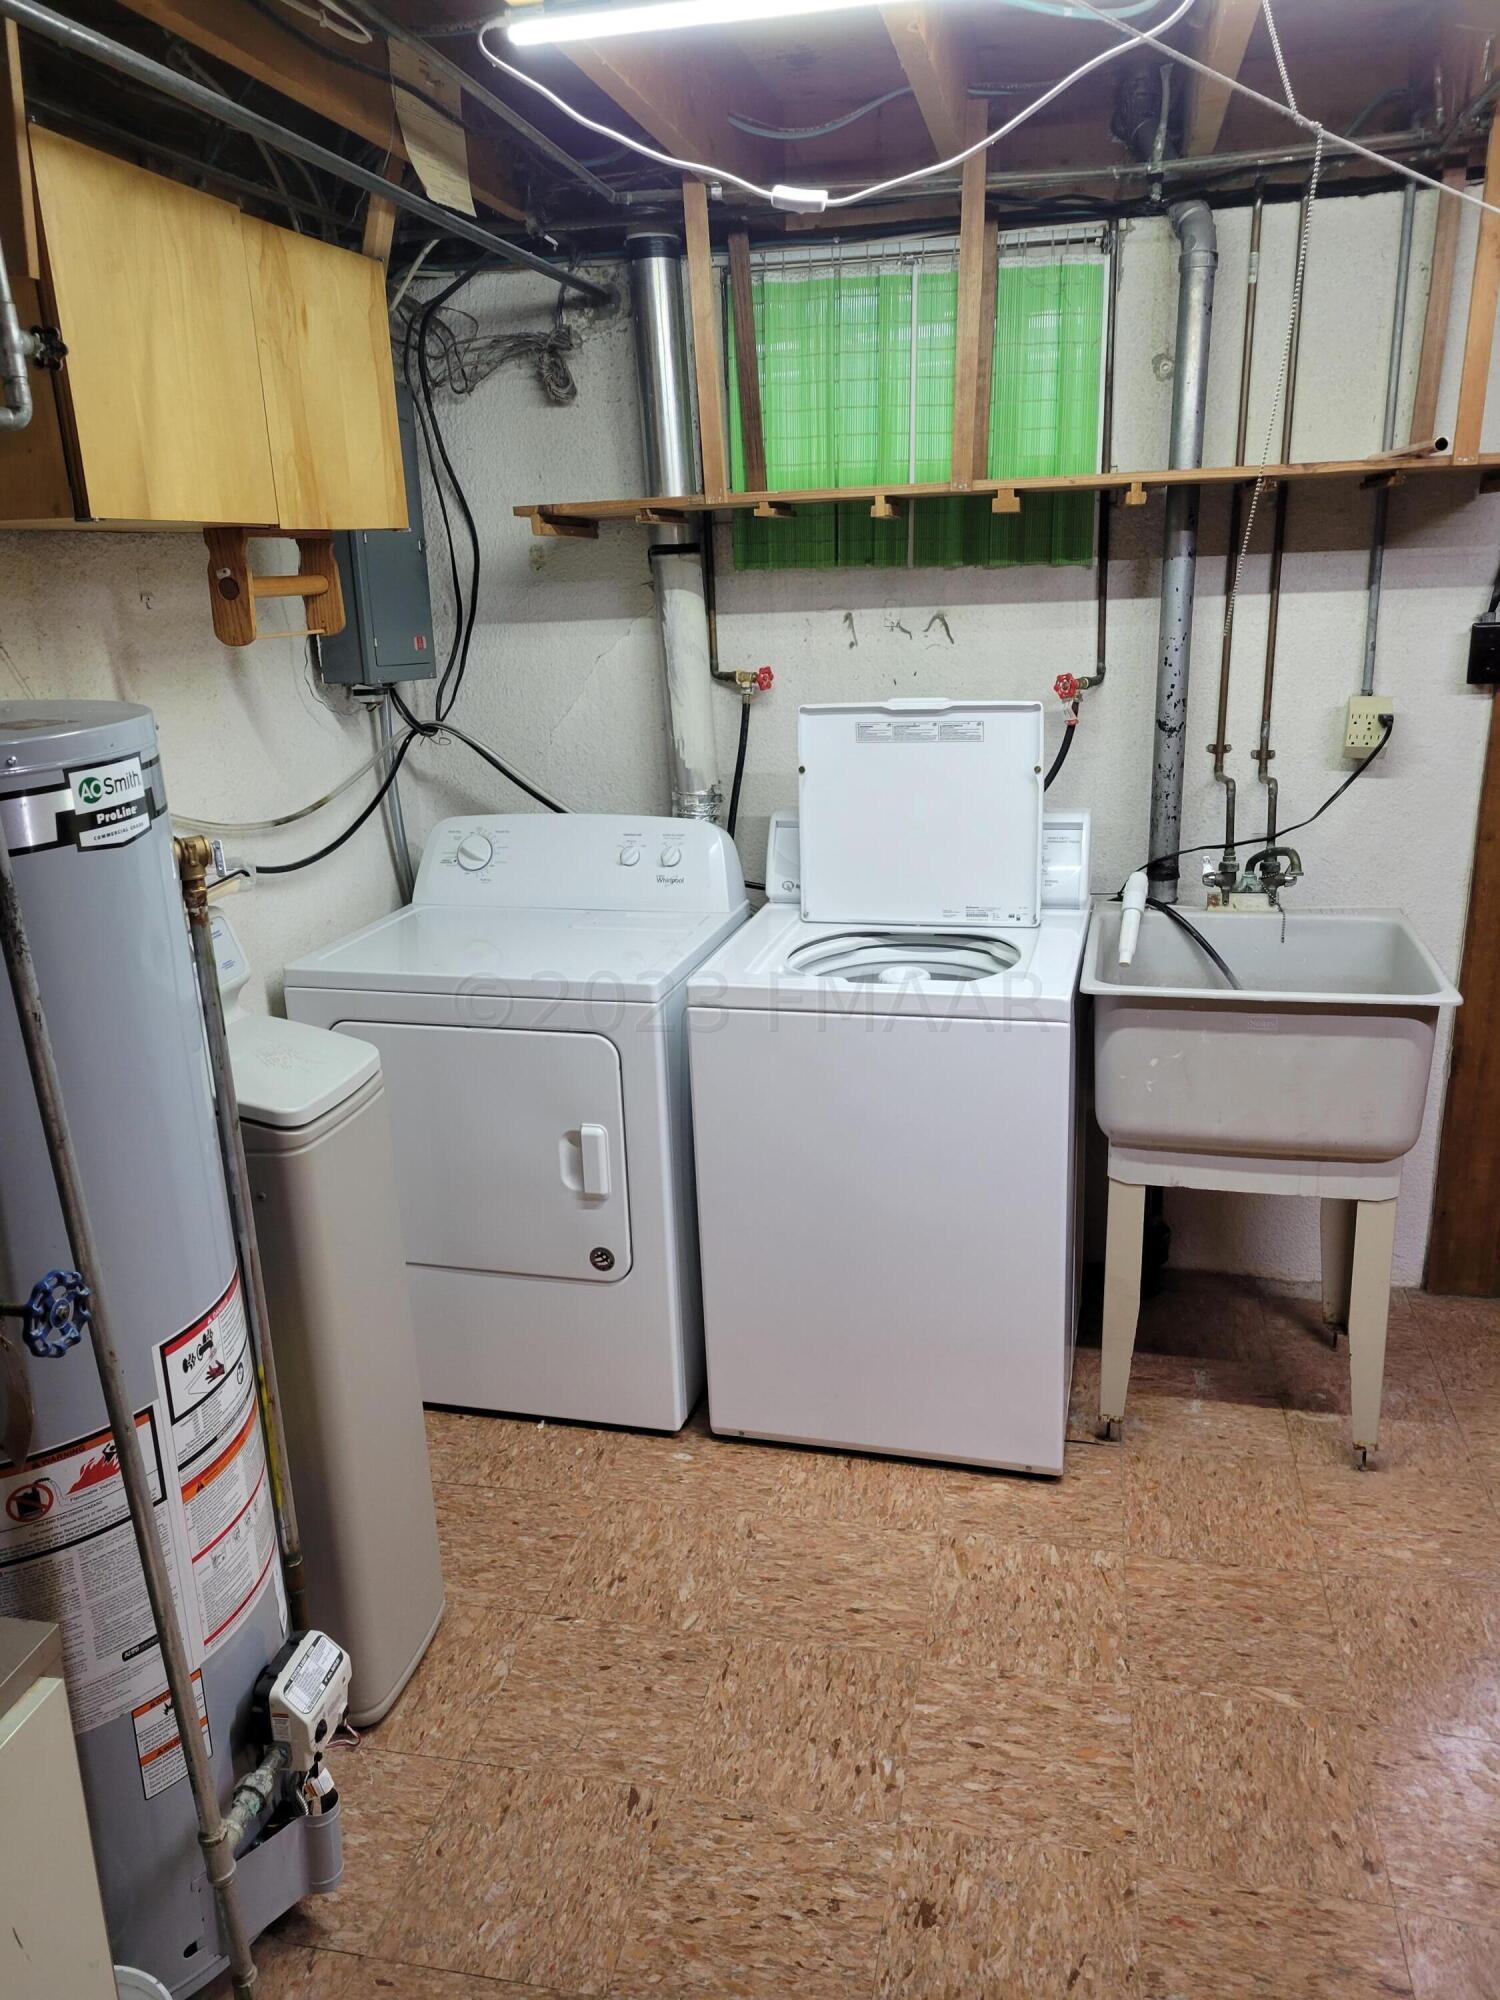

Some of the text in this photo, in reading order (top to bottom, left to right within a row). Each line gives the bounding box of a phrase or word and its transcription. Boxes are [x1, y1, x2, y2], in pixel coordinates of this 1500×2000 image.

[104, 771, 140, 795] Smith
[96, 805, 137, 825] ProLine
[93, 828, 129, 840] COMMERCIAL
[656, 875, 685, 886] Whirlpool
[41, 1446, 86, 1465] WARNING
